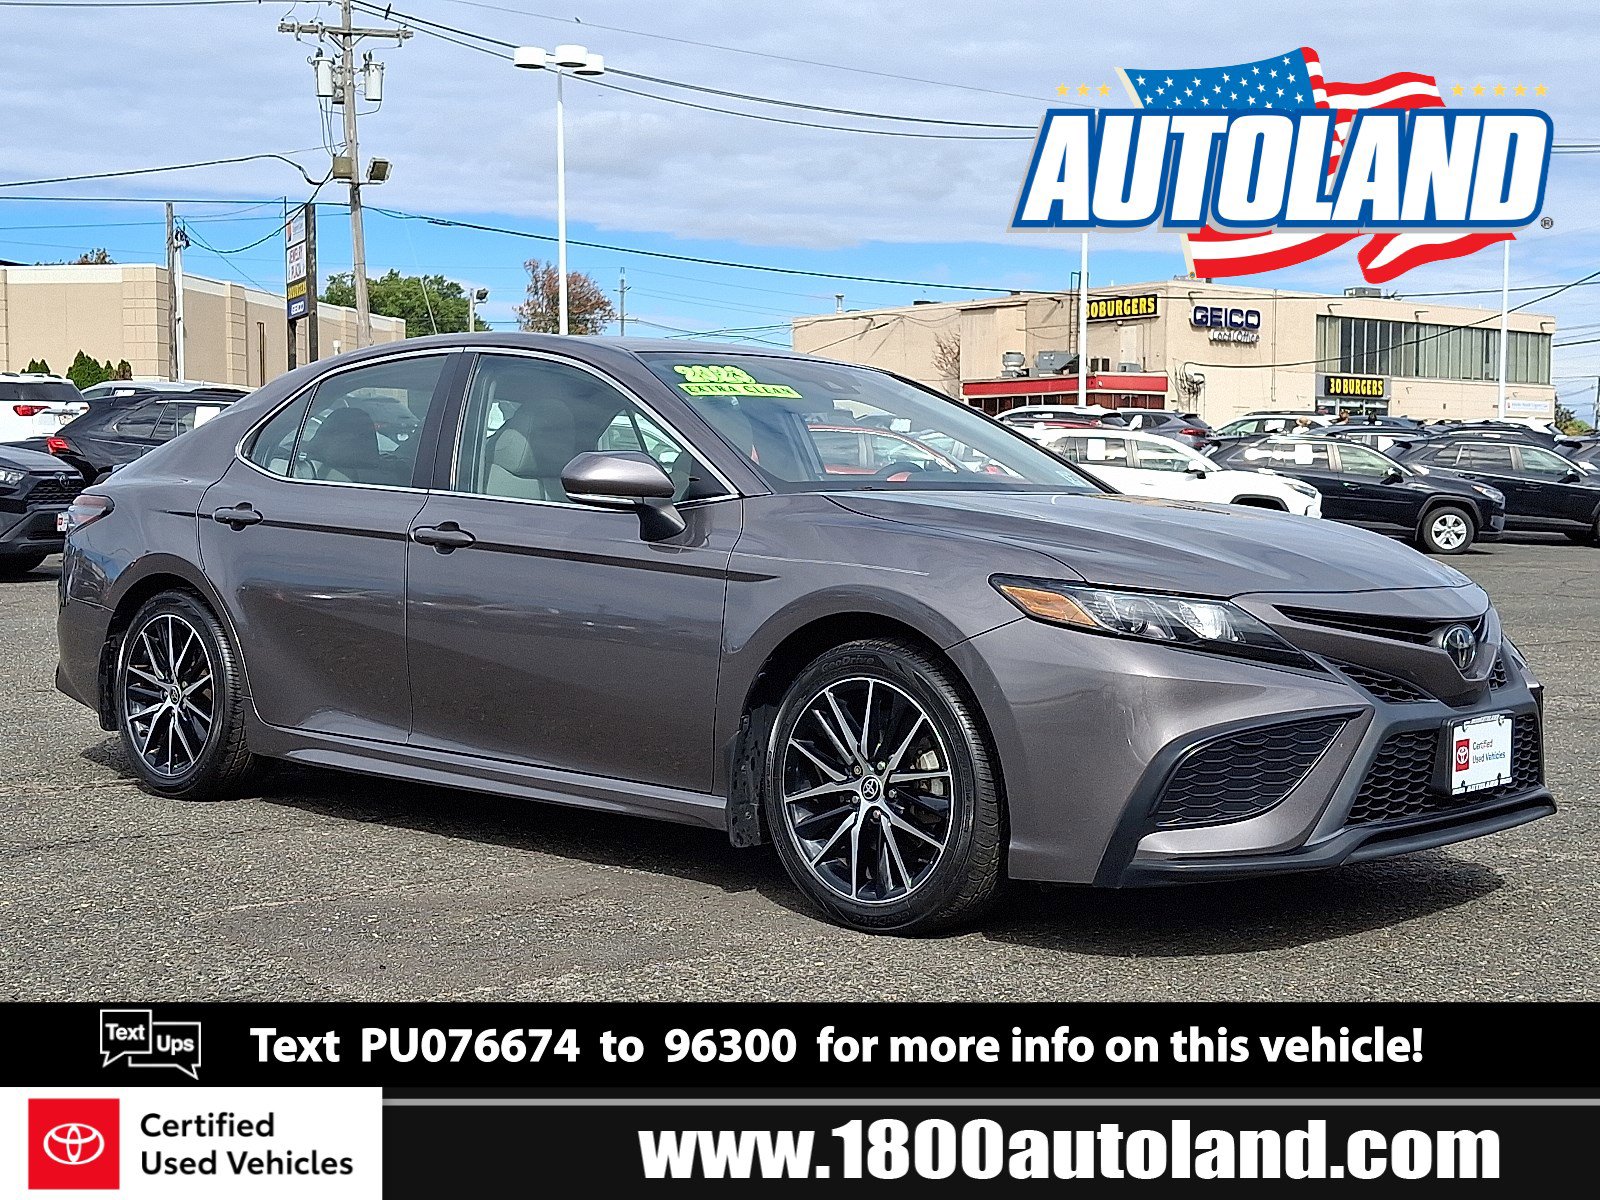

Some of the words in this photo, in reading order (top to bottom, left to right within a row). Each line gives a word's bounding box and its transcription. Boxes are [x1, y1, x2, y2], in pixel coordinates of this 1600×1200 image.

[1194, 306, 1260, 329] GEICO
[685, 384, 739, 395] EXTRA
[742, 385, 794, 396] CLEAN
[1472, 738, 1493, 751] Certified
[1472, 753, 1485, 764] Used
[1485, 751, 1506, 762] Vehicles
